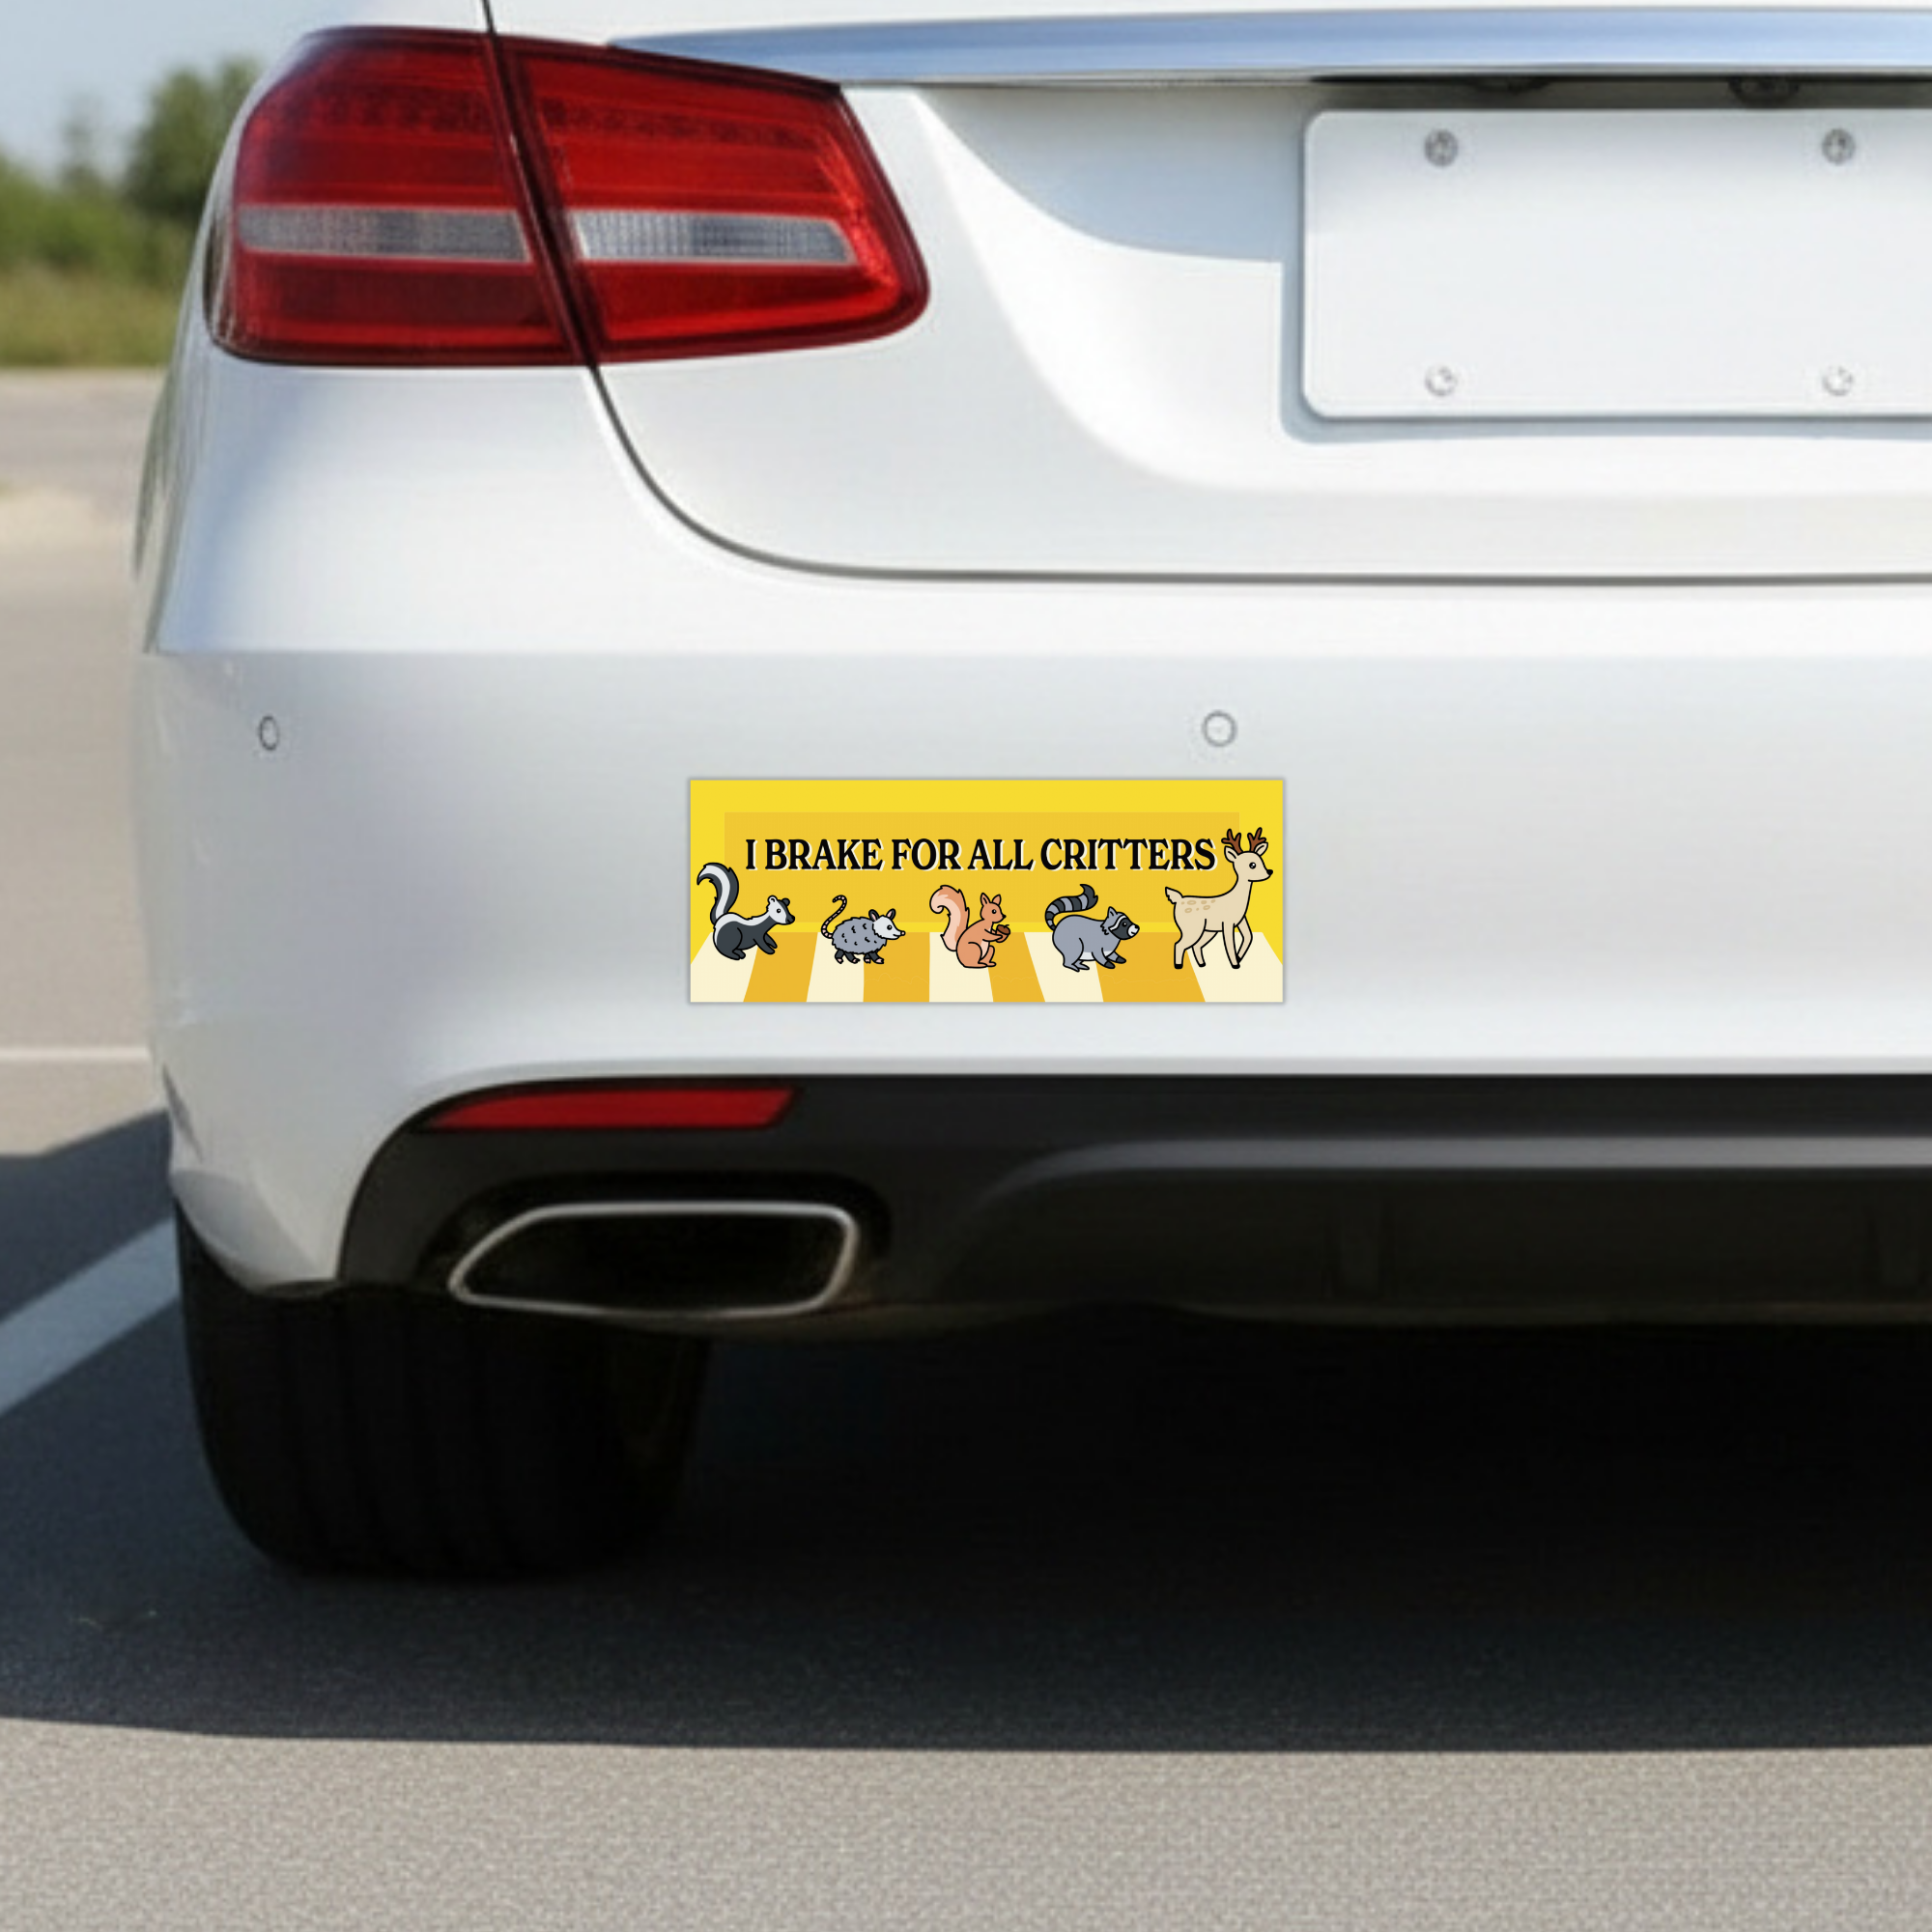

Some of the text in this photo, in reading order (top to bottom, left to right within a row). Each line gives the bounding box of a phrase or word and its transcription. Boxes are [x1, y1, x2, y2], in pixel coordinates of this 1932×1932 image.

[745, 838, 1217, 871] I BRAKE FOR ALL CRITTERS
